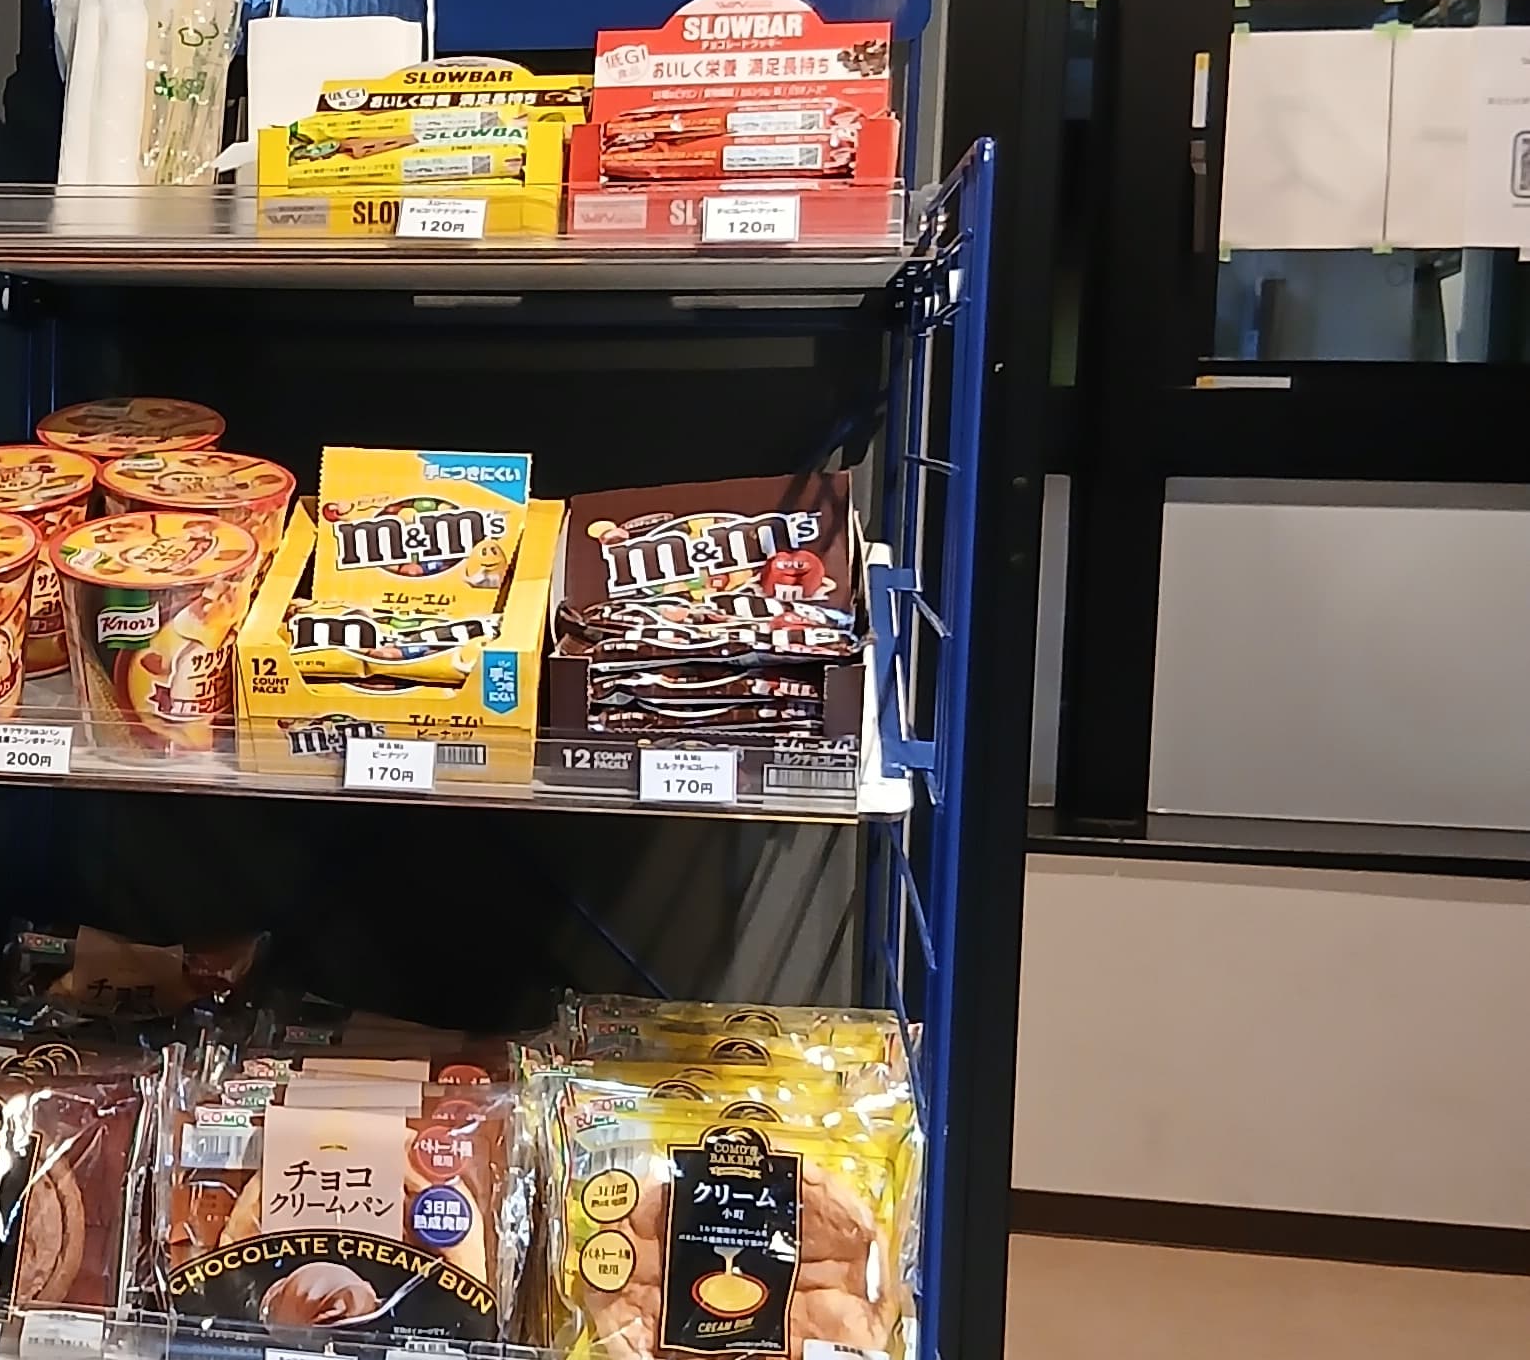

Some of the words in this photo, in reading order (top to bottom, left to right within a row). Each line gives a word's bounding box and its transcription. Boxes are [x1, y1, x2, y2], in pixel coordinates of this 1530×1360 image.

[682, 14, 804, 41] SLOWBAR
[402, 70, 513, 85] SLOWBAR
[669, 199, 702, 226] SL
[420, 220, 465, 234] 120円
[728, 220, 776, 235] 120円
[338, 510, 505, 565] m&m's
[607, 517, 816, 587] m&m's
[99, 615, 157, 632] Knorr
[251, 657, 277, 676] 12
[252, 677, 290, 686] COUNT
[252, 685, 287, 695] PACKS
[6, 751, 52, 768] 200円
[562, 748, 591, 769] 12
[366, 765, 414, 783] 170円
[662, 778, 714, 795] 170円
[284, 1159, 374, 1192] チョコ
[693, 1181, 777, 1208] クリーム
[269, 1193, 395, 1218] クリームパン
[422, 1199, 461, 1215] 3日間
[721, 1208, 745, 1221] 小町
[170, 1237, 328, 1296] CHOCOLATE
[337, 1238, 433, 1278] CREAM
[437, 1270, 494, 1315] BUN
